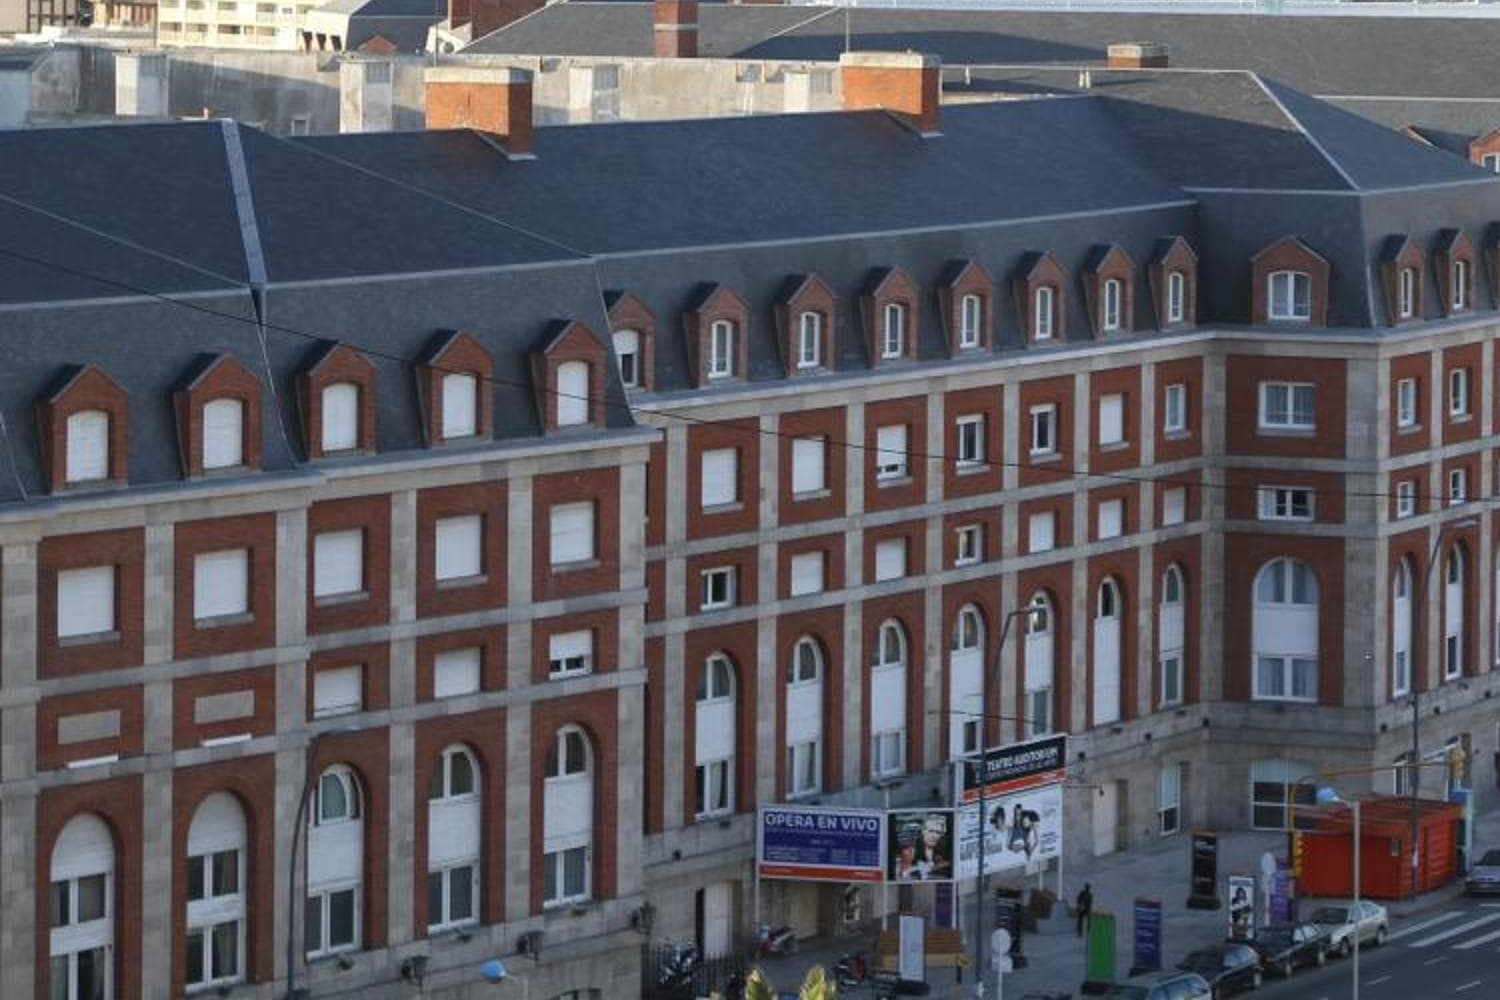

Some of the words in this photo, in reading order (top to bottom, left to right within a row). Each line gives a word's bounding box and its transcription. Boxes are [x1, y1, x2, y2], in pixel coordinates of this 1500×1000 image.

[765, 813, 814, 828] OPERA
[817, 816, 837, 829] EN
[840, 817, 878, 831] VIVO
